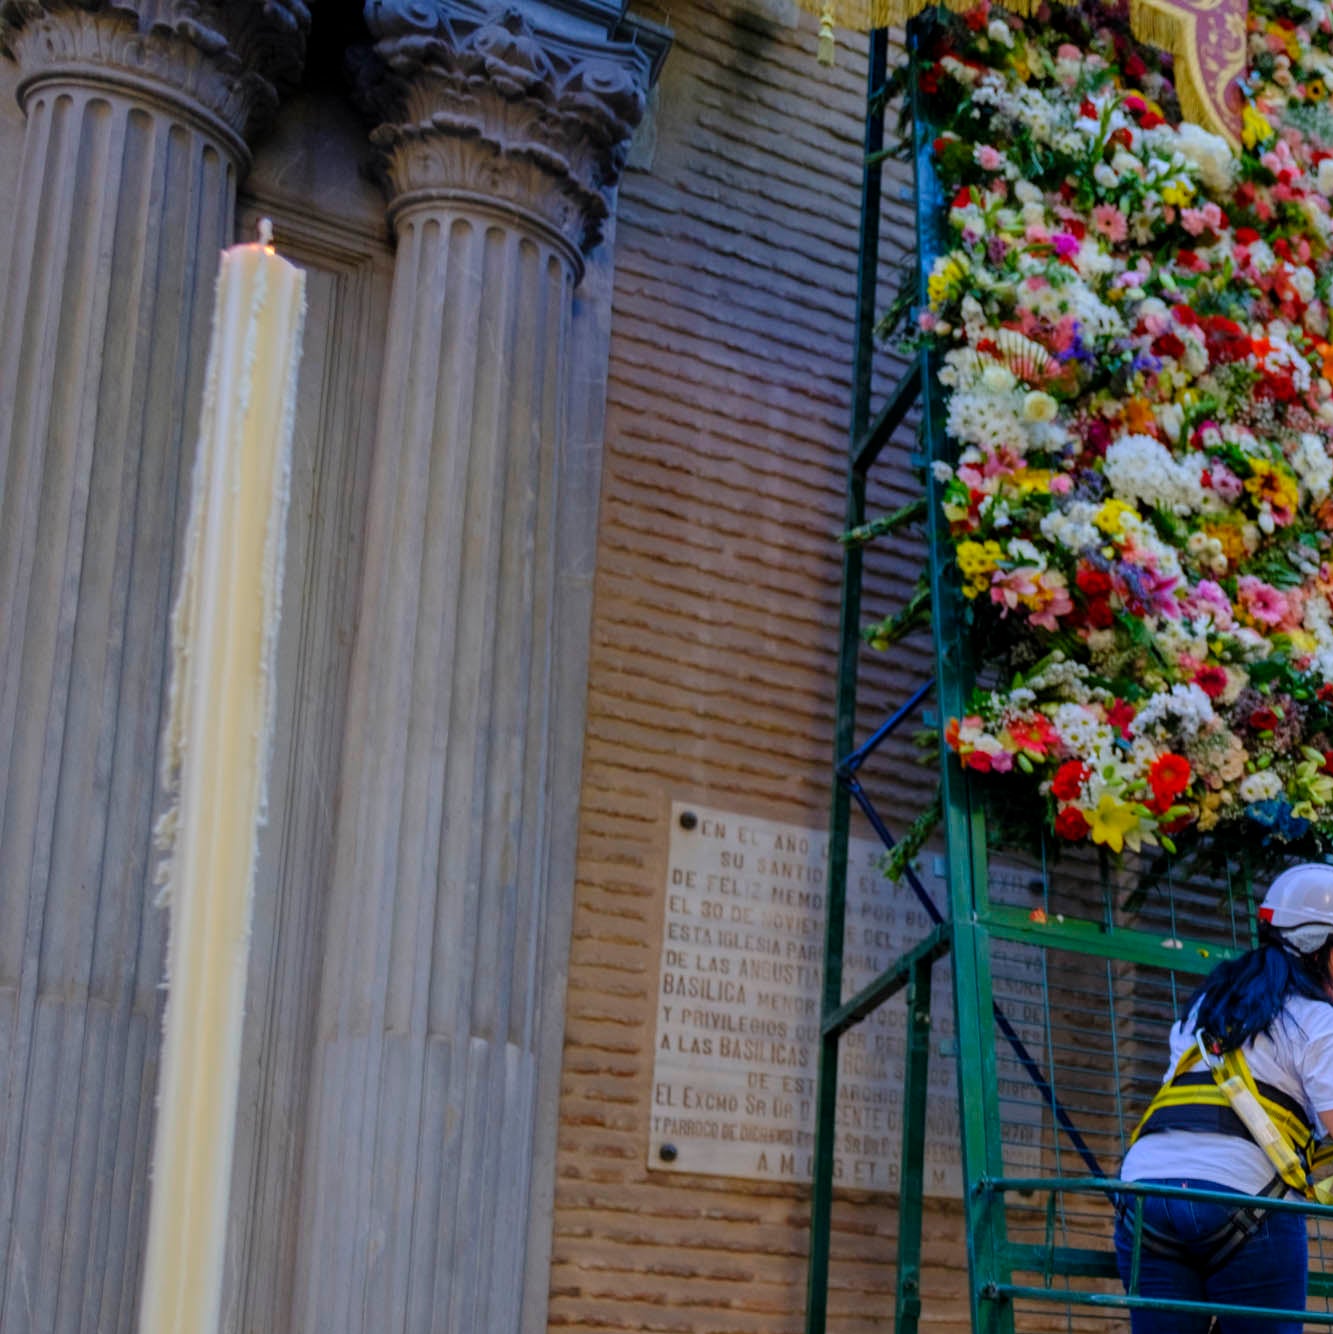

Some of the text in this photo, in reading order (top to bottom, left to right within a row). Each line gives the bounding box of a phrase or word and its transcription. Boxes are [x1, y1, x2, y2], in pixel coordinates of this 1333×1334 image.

[701, 819, 726, 839] EN
[672, 868, 697, 889] DE
[720, 850, 744, 870] SU
[757, 857, 824, 884] SANTID
[669, 895, 692, 915] EL
[701, 901, 724, 920] 30
[731, 906, 753, 926] DE
[667, 922, 712, 945] ESTA
[718, 931, 781, 954] IGLESIA
[666, 949, 688, 969] DE
[696, 955, 730, 975] LAS
[663, 973, 746, 1006] BASILICA
[663, 1006, 672, 1022] Y
[682, 1008, 788, 1039] PRIVILEGIOS
[660, 1033, 671, 1050] A
[678, 1035, 713, 1055] LAS
[720, 1036, 809, 1067] BASILICAS
[655, 1082, 676, 1106] EL
